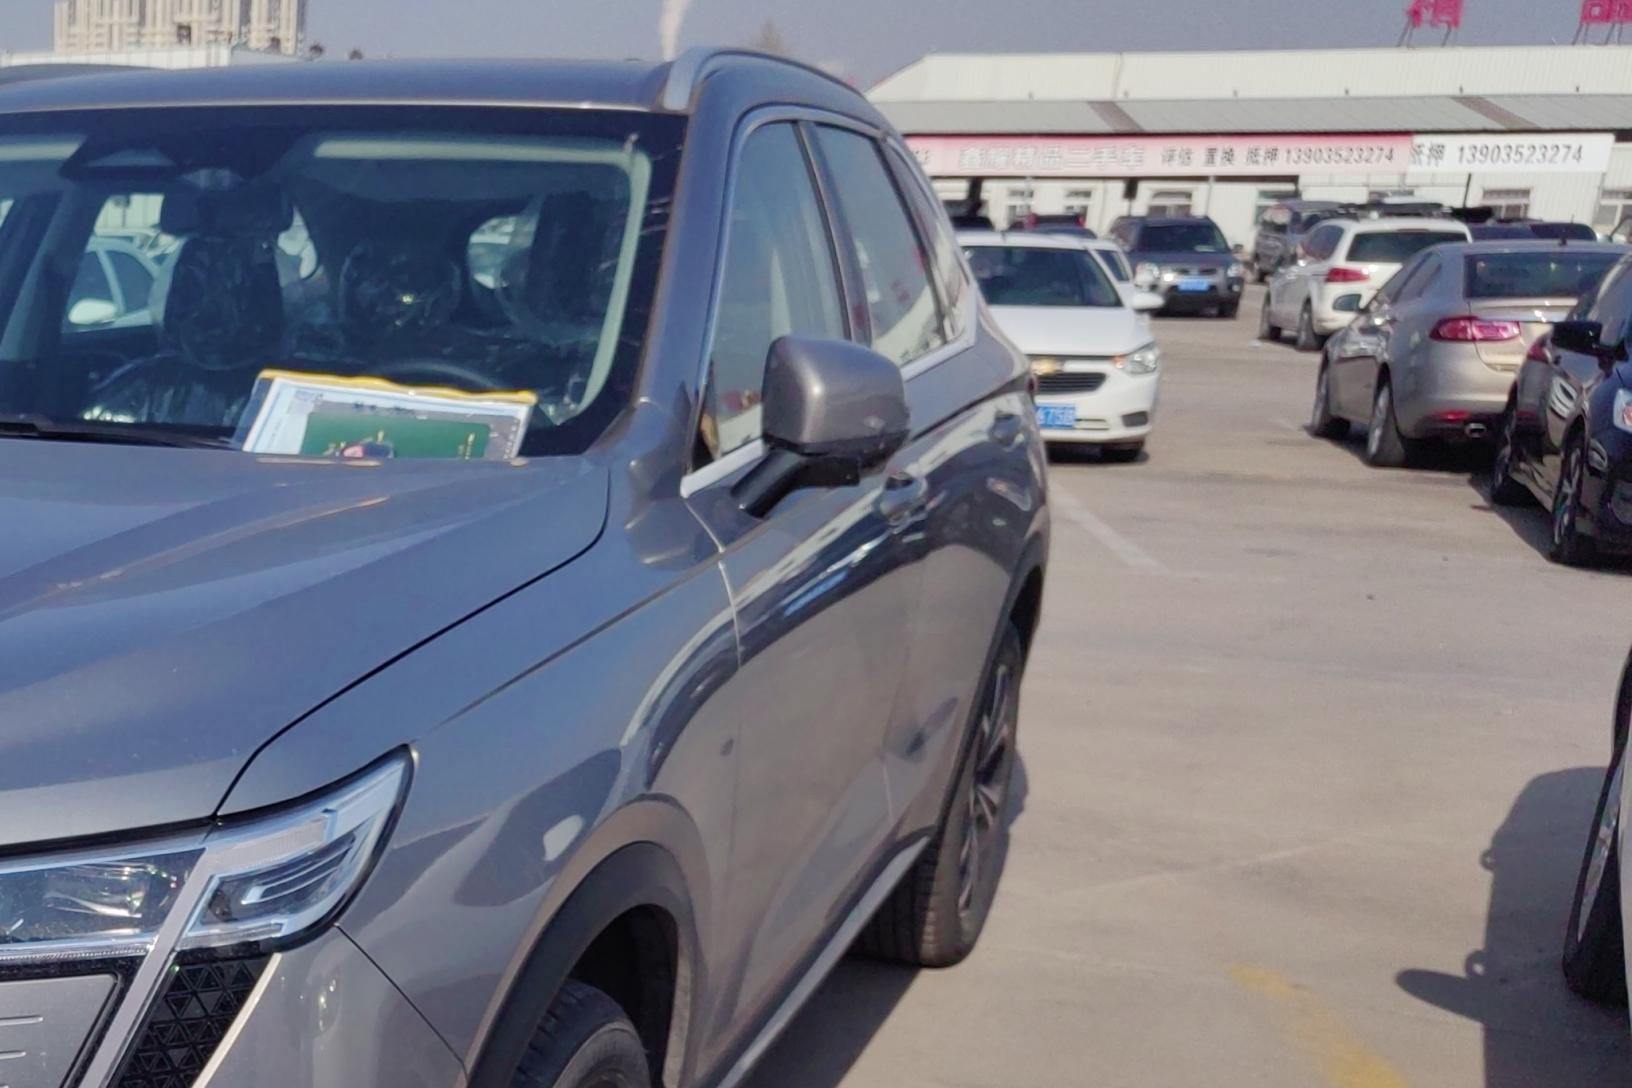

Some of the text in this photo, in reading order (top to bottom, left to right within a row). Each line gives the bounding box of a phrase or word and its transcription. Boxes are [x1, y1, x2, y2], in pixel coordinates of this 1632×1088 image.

[1203, 145, 1235, 166] 置换
[1246, 144, 1279, 166] 抵押
[1284, 144, 1395, 166] 13903523274
[1456, 143, 1584, 166] 13903523274
